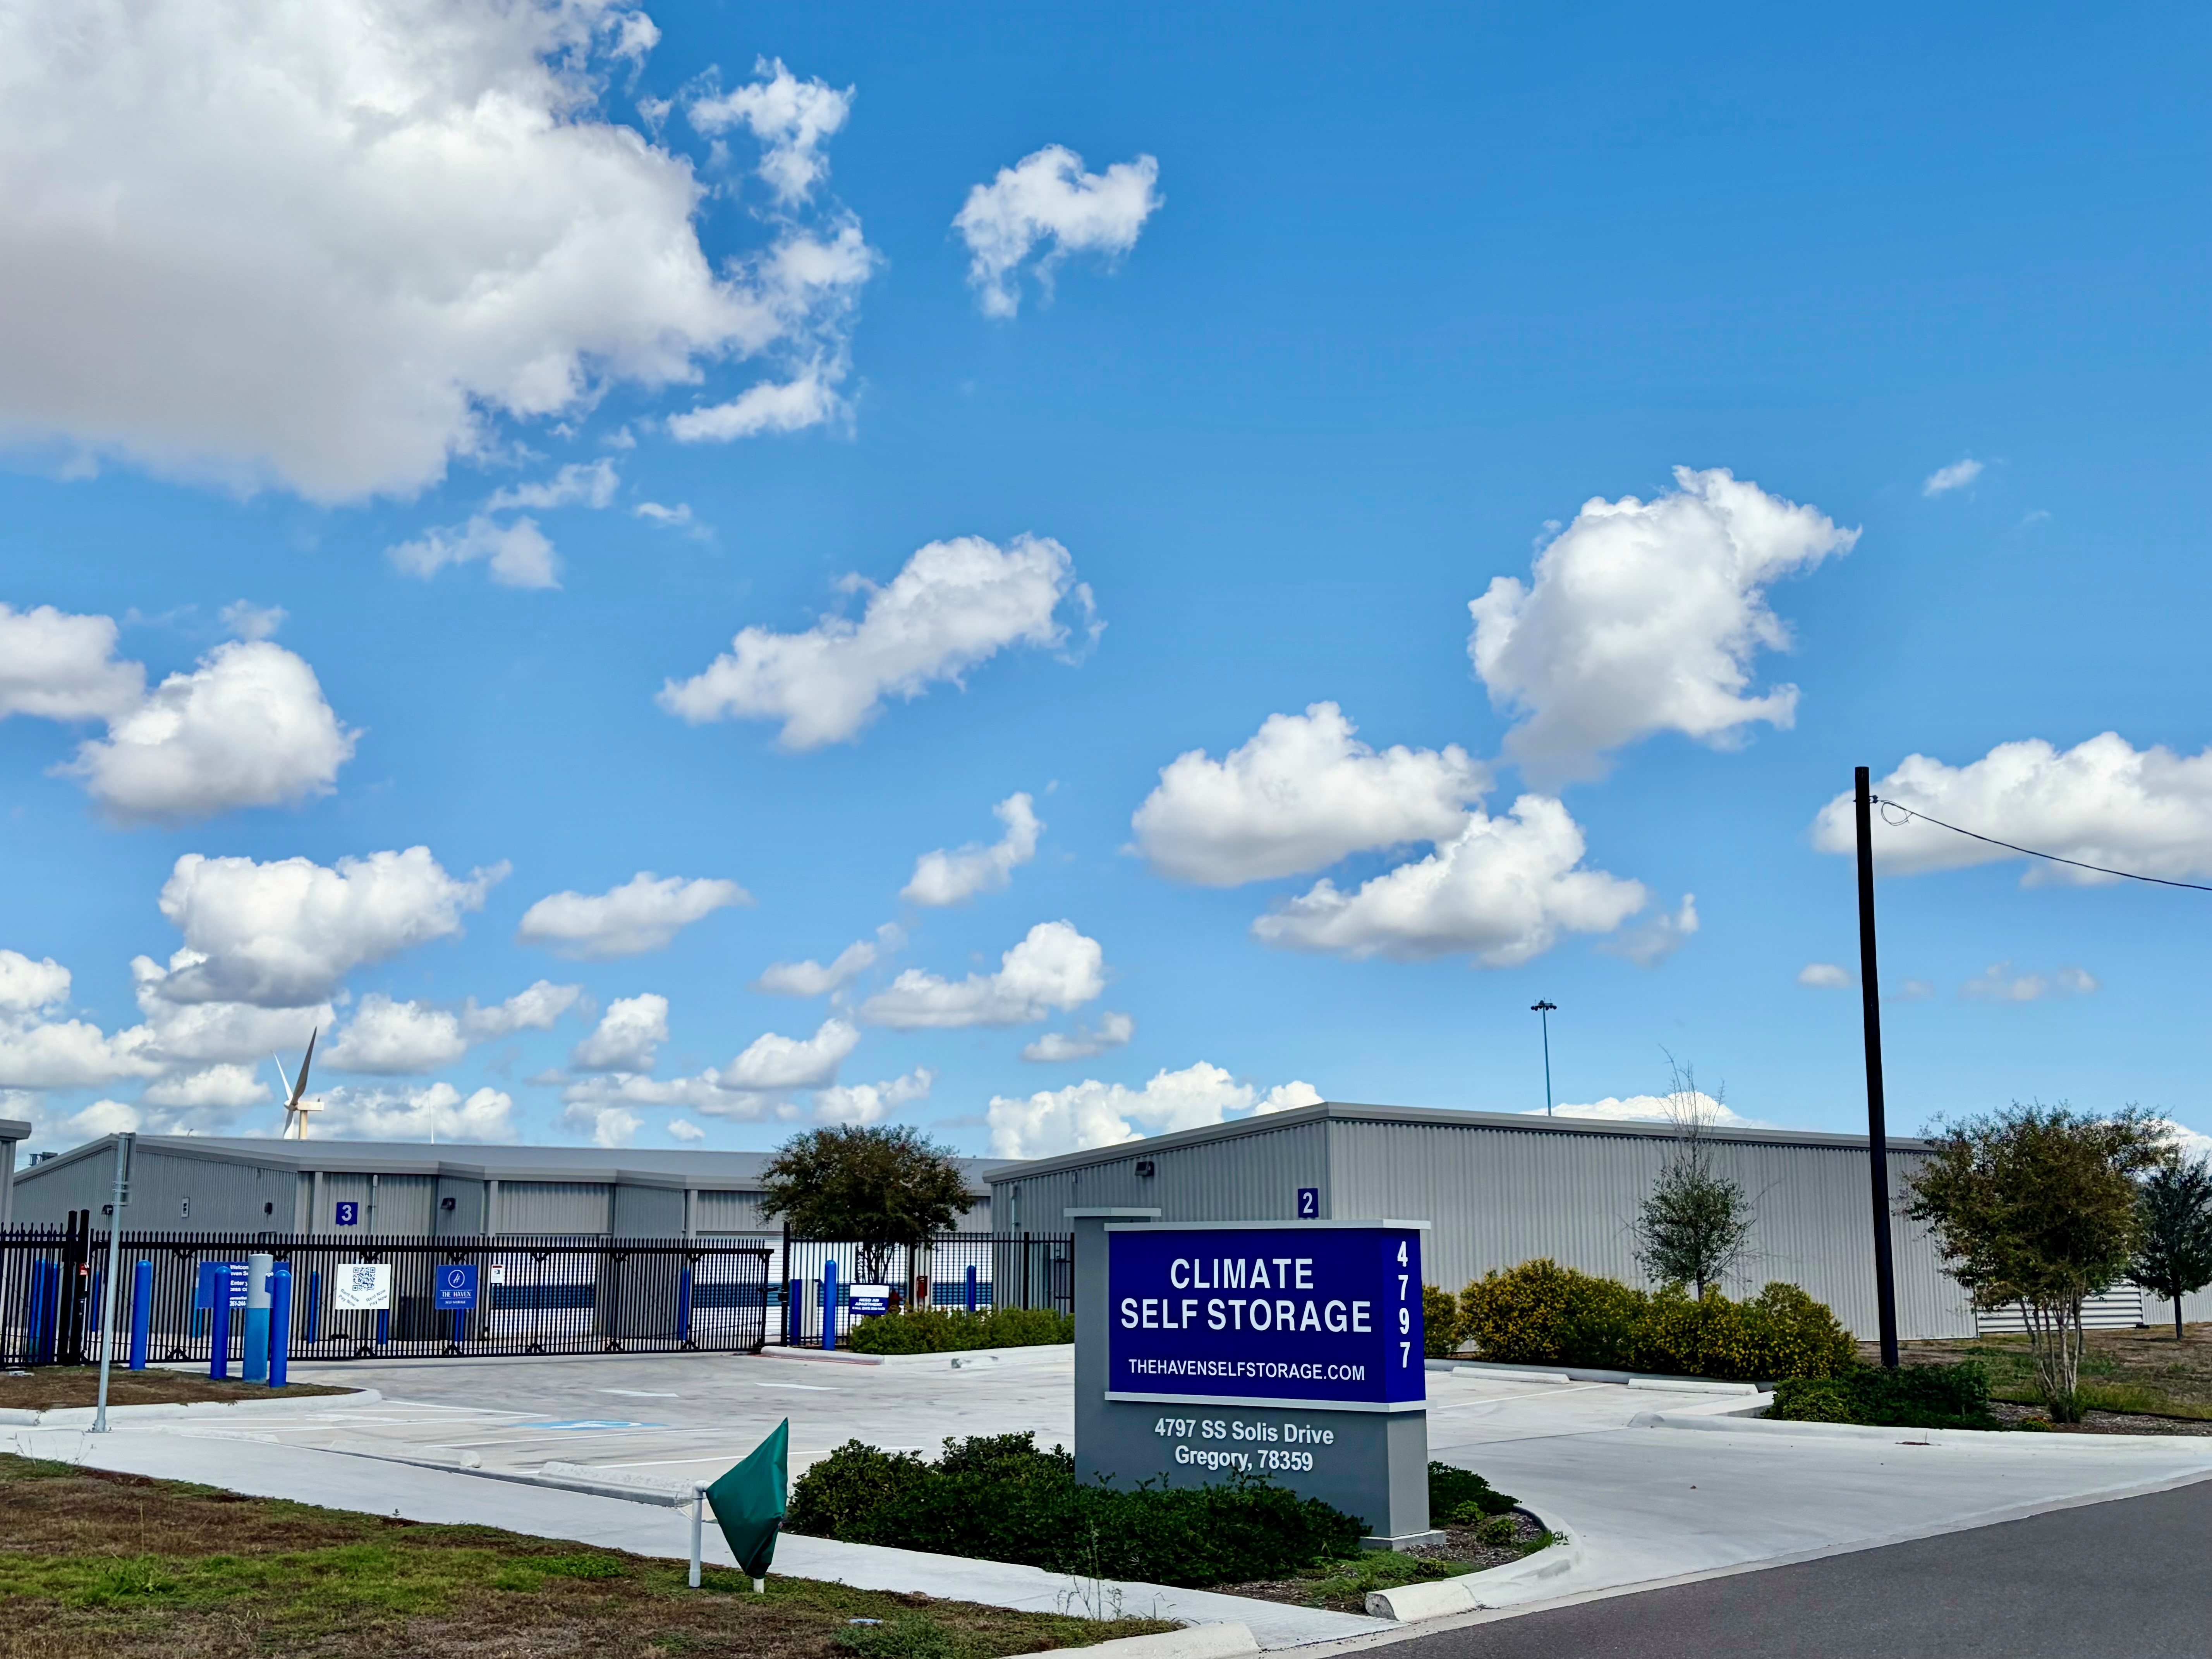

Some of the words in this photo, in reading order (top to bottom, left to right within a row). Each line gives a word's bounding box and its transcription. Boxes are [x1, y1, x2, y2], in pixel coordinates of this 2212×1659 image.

[341, 1204, 352, 1221] 3
[1303, 1192, 1313, 1213] 2
[1171, 1258, 1314, 1289] CLIMATE
[1121, 1298, 1198, 1329] SELF
[1207, 1298, 1372, 1332] STORAGE
[1397, 1241, 1410, 1368] 4797
[1128, 1359, 1365, 1381] THEHAVENSELFSTORAGE.COM
[1155, 1418, 1195, 1437] 4797
[1202, 1420, 1226, 1439] SS
[1232, 1421, 1278, 1442] Solis
[1285, 1424, 1334, 1444] Drive
[1175, 1445, 1252, 1471] Gregory,
[1258, 1450, 1313, 1471] 78359
